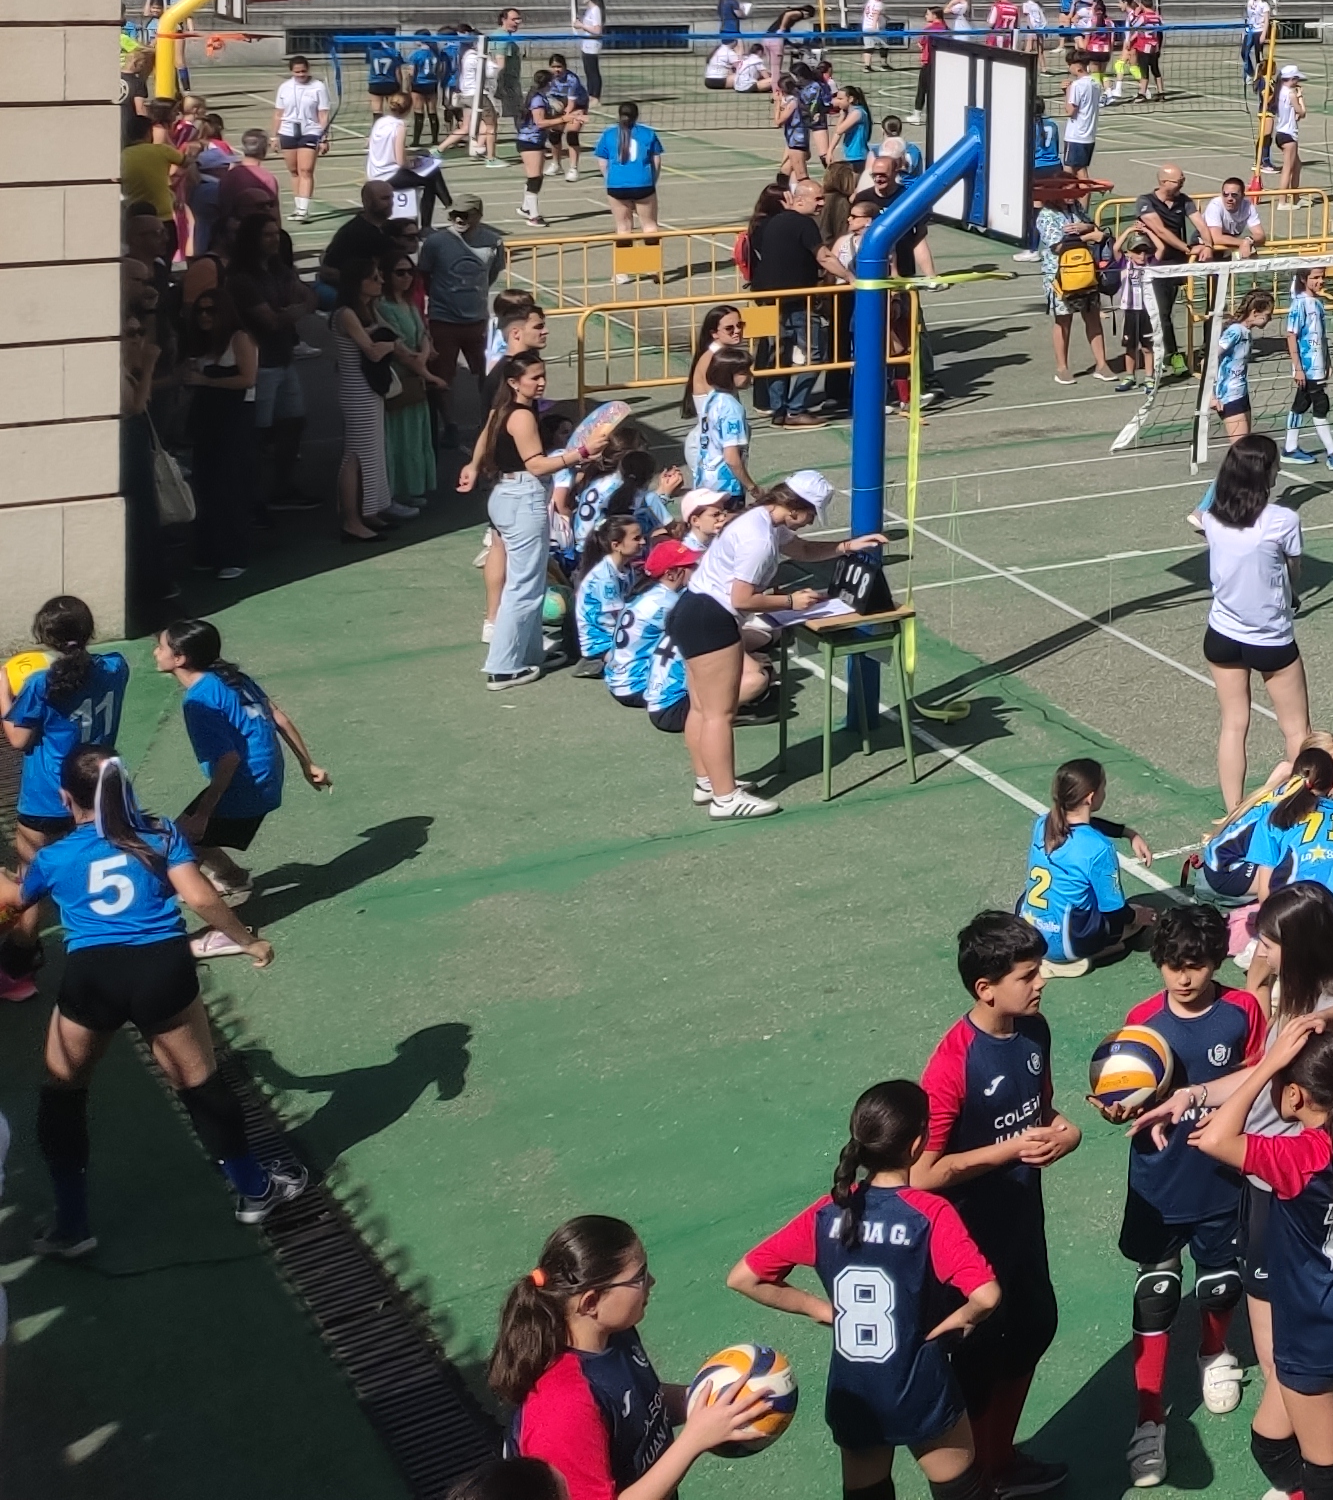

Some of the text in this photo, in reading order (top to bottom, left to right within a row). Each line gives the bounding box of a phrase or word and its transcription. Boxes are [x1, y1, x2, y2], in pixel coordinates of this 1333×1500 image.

[373, 58, 392, 75] 17
[397, 193, 408, 207] 9
[69, 691, 115, 745] 11
[88, 854, 135, 916] 5
[1027, 866, 1053, 909] 2
[890, 1224, 910, 1246] G.
[833, 1265, 896, 1364] 8
